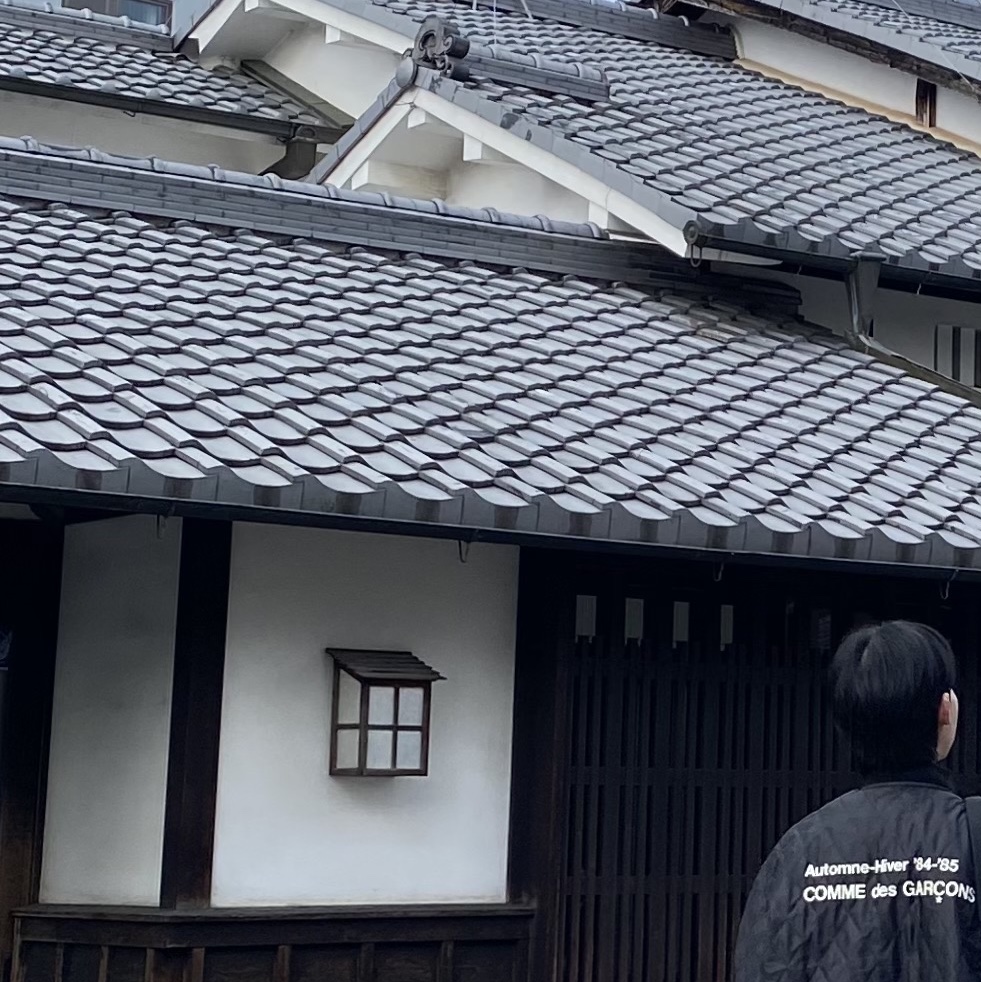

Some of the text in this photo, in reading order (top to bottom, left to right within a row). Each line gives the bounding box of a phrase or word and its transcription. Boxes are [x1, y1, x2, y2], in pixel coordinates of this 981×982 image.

[804, 858, 909, 877] Automne-Hiver
[803, 880, 976, 904] COMME des GARÇONS
